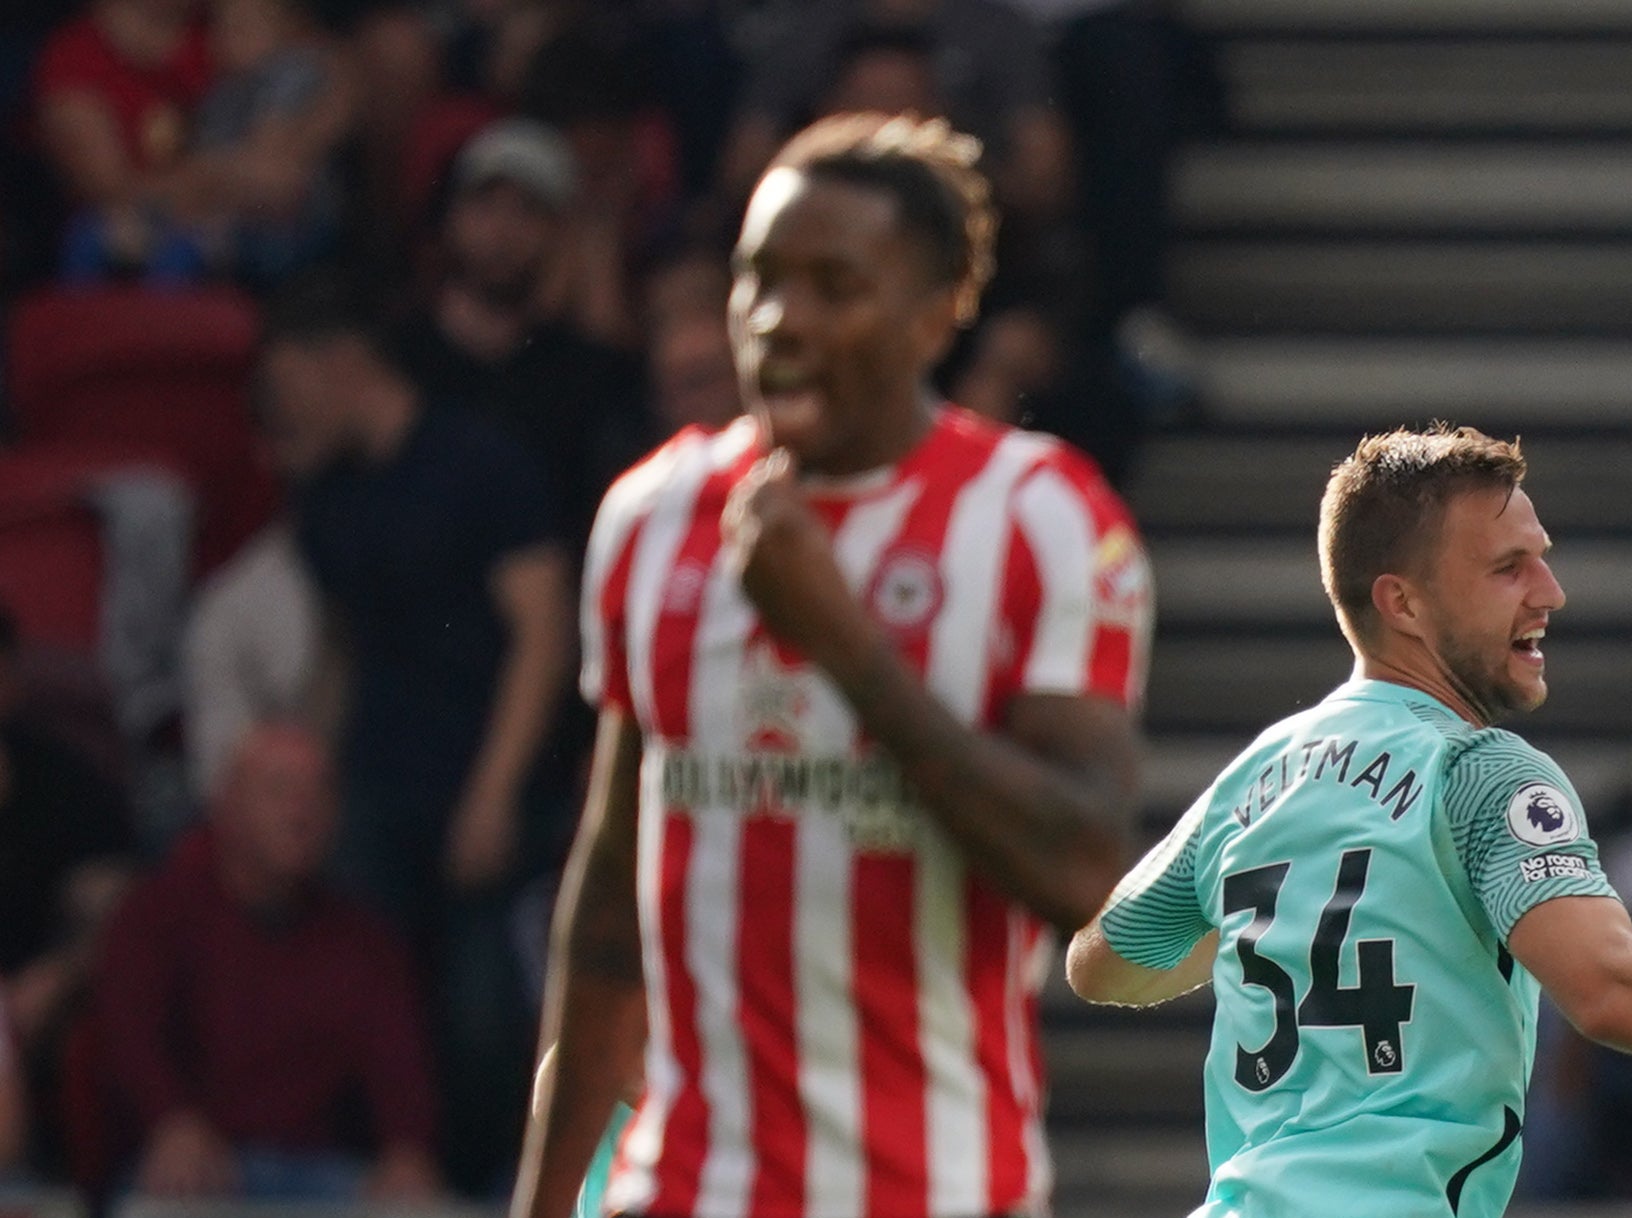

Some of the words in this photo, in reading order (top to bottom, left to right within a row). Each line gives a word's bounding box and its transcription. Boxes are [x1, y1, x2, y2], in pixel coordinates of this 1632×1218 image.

[1234, 739, 1424, 821] VELTMAN
[1520, 857, 1546, 873] No
[1546, 854, 1586, 869] room
[1223, 847, 1418, 1094] 34
